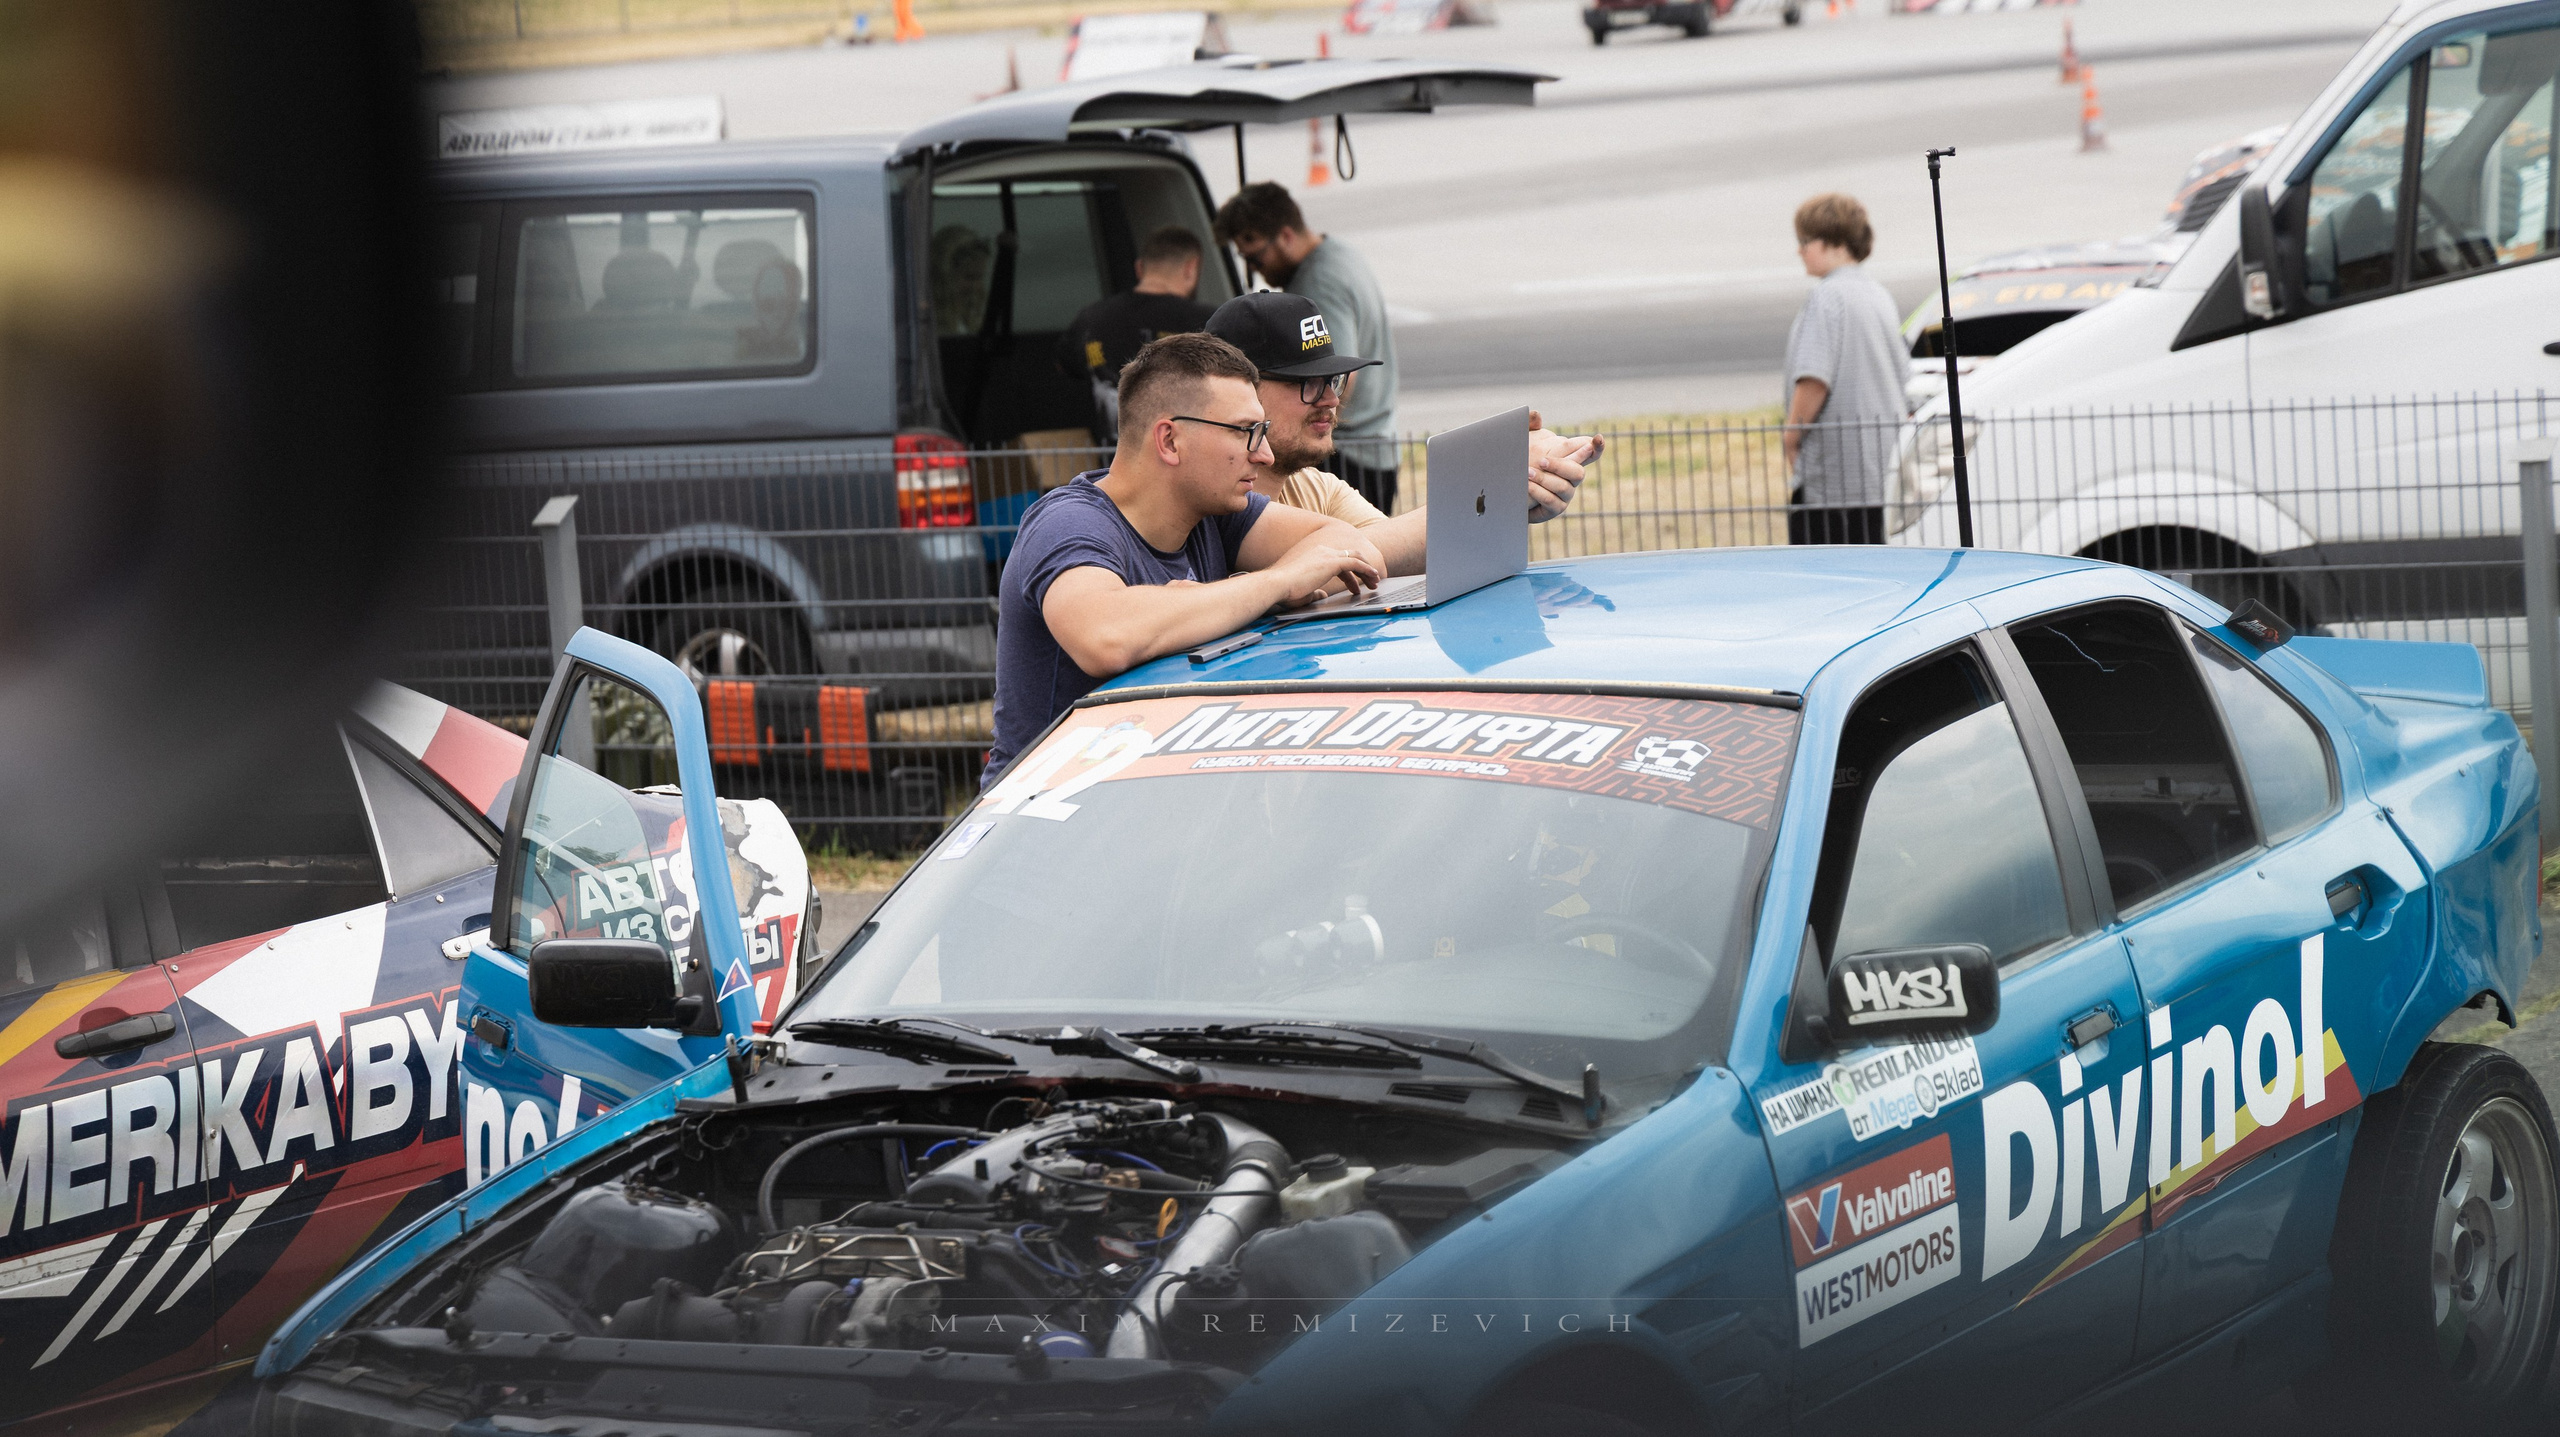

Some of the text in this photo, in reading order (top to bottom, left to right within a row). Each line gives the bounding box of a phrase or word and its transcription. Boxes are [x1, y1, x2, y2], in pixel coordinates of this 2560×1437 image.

[445, 129, 554, 151] АВТОДРОМ
[1191, 755, 1510, 777] КУБОК РЕСПУБЛИКИ БЕЛАРУСЬ
[1766, 1080, 1839, 1131] НА ШИНАХ
[1869, 1092, 1918, 1129] Mega
[1932, 1058, 1981, 1103] Sklad
[1981, 932, 2326, 1282] Divinol
[1843, 1166, 1953, 1237] Valvoline
[1803, 1225, 1955, 1326] WESTMOTORS
